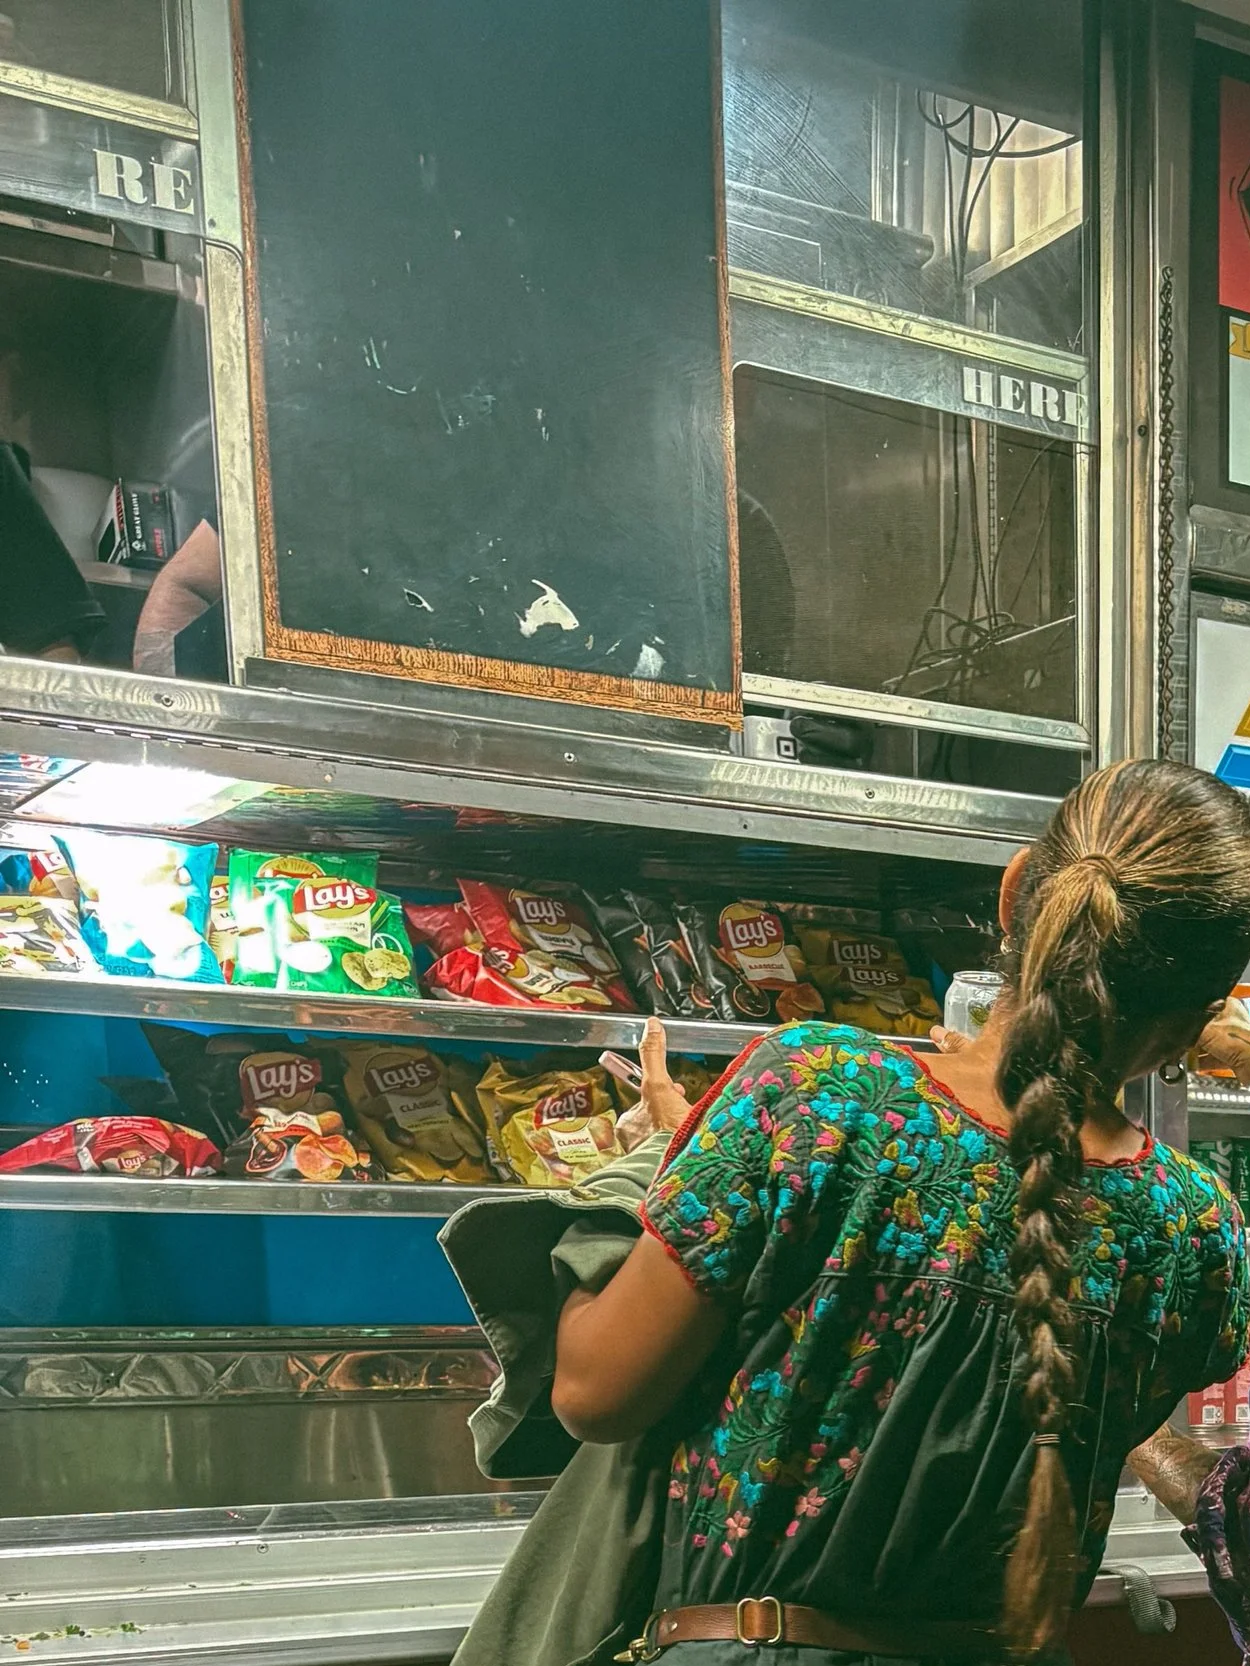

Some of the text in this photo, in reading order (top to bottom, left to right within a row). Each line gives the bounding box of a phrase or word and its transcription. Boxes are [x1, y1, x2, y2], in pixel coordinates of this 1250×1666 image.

[92, 148, 195, 214] RE
[963, 366, 1089, 429] HERE
[303, 884, 370, 911] Lay's
[725, 914, 777, 949] Lay's
[847, 967, 900, 986] Lay's
[247, 1059, 315, 1101] Lay's
[370, 1061, 431, 1092] Lay's
[541, 1088, 587, 1125] Lay's
[557, 1138, 591, 1147] CLASSIC
